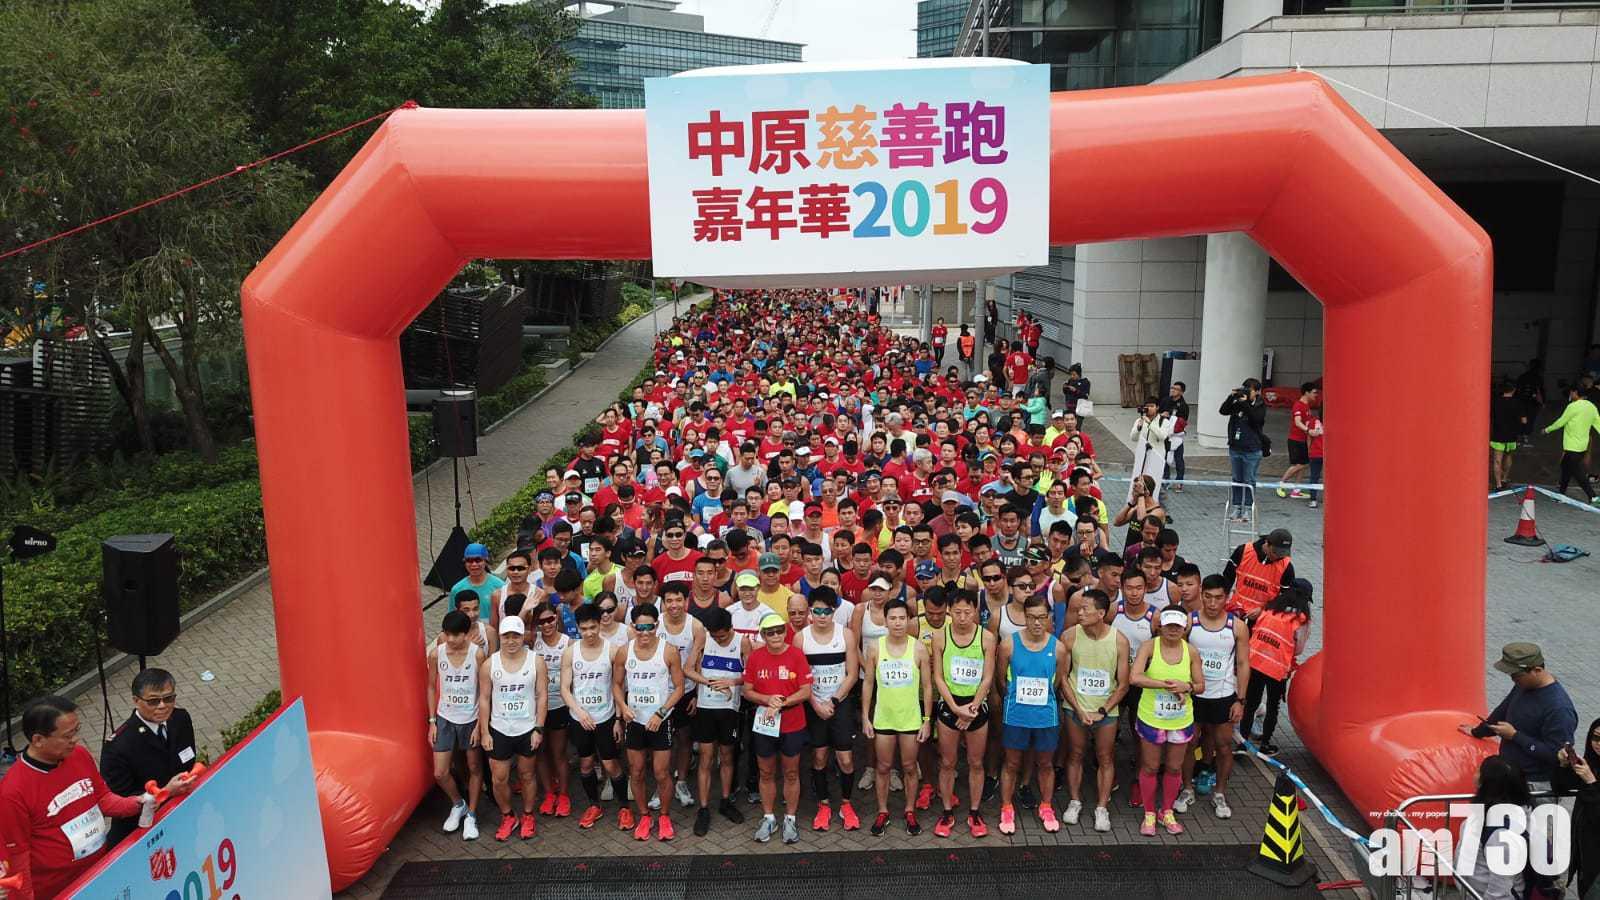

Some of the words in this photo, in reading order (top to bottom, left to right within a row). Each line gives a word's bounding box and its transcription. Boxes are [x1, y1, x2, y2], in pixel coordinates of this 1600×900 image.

[687, 100, 1008, 176] 中原慈善跑
[692, 177, 1008, 242] 嘉年華2019
[886, 671, 908, 679] 1215
[956, 667, 977, 677] 1189
[816, 676, 838, 684] 1472
[1082, 678, 1105, 688] 1328
[1021, 687, 1044, 697] 1287
[447, 695, 469, 704] 1002
[581, 696, 602, 704] 1039
[634, 696, 655, 704] 1490
[503, 702, 524, 711] 1057
